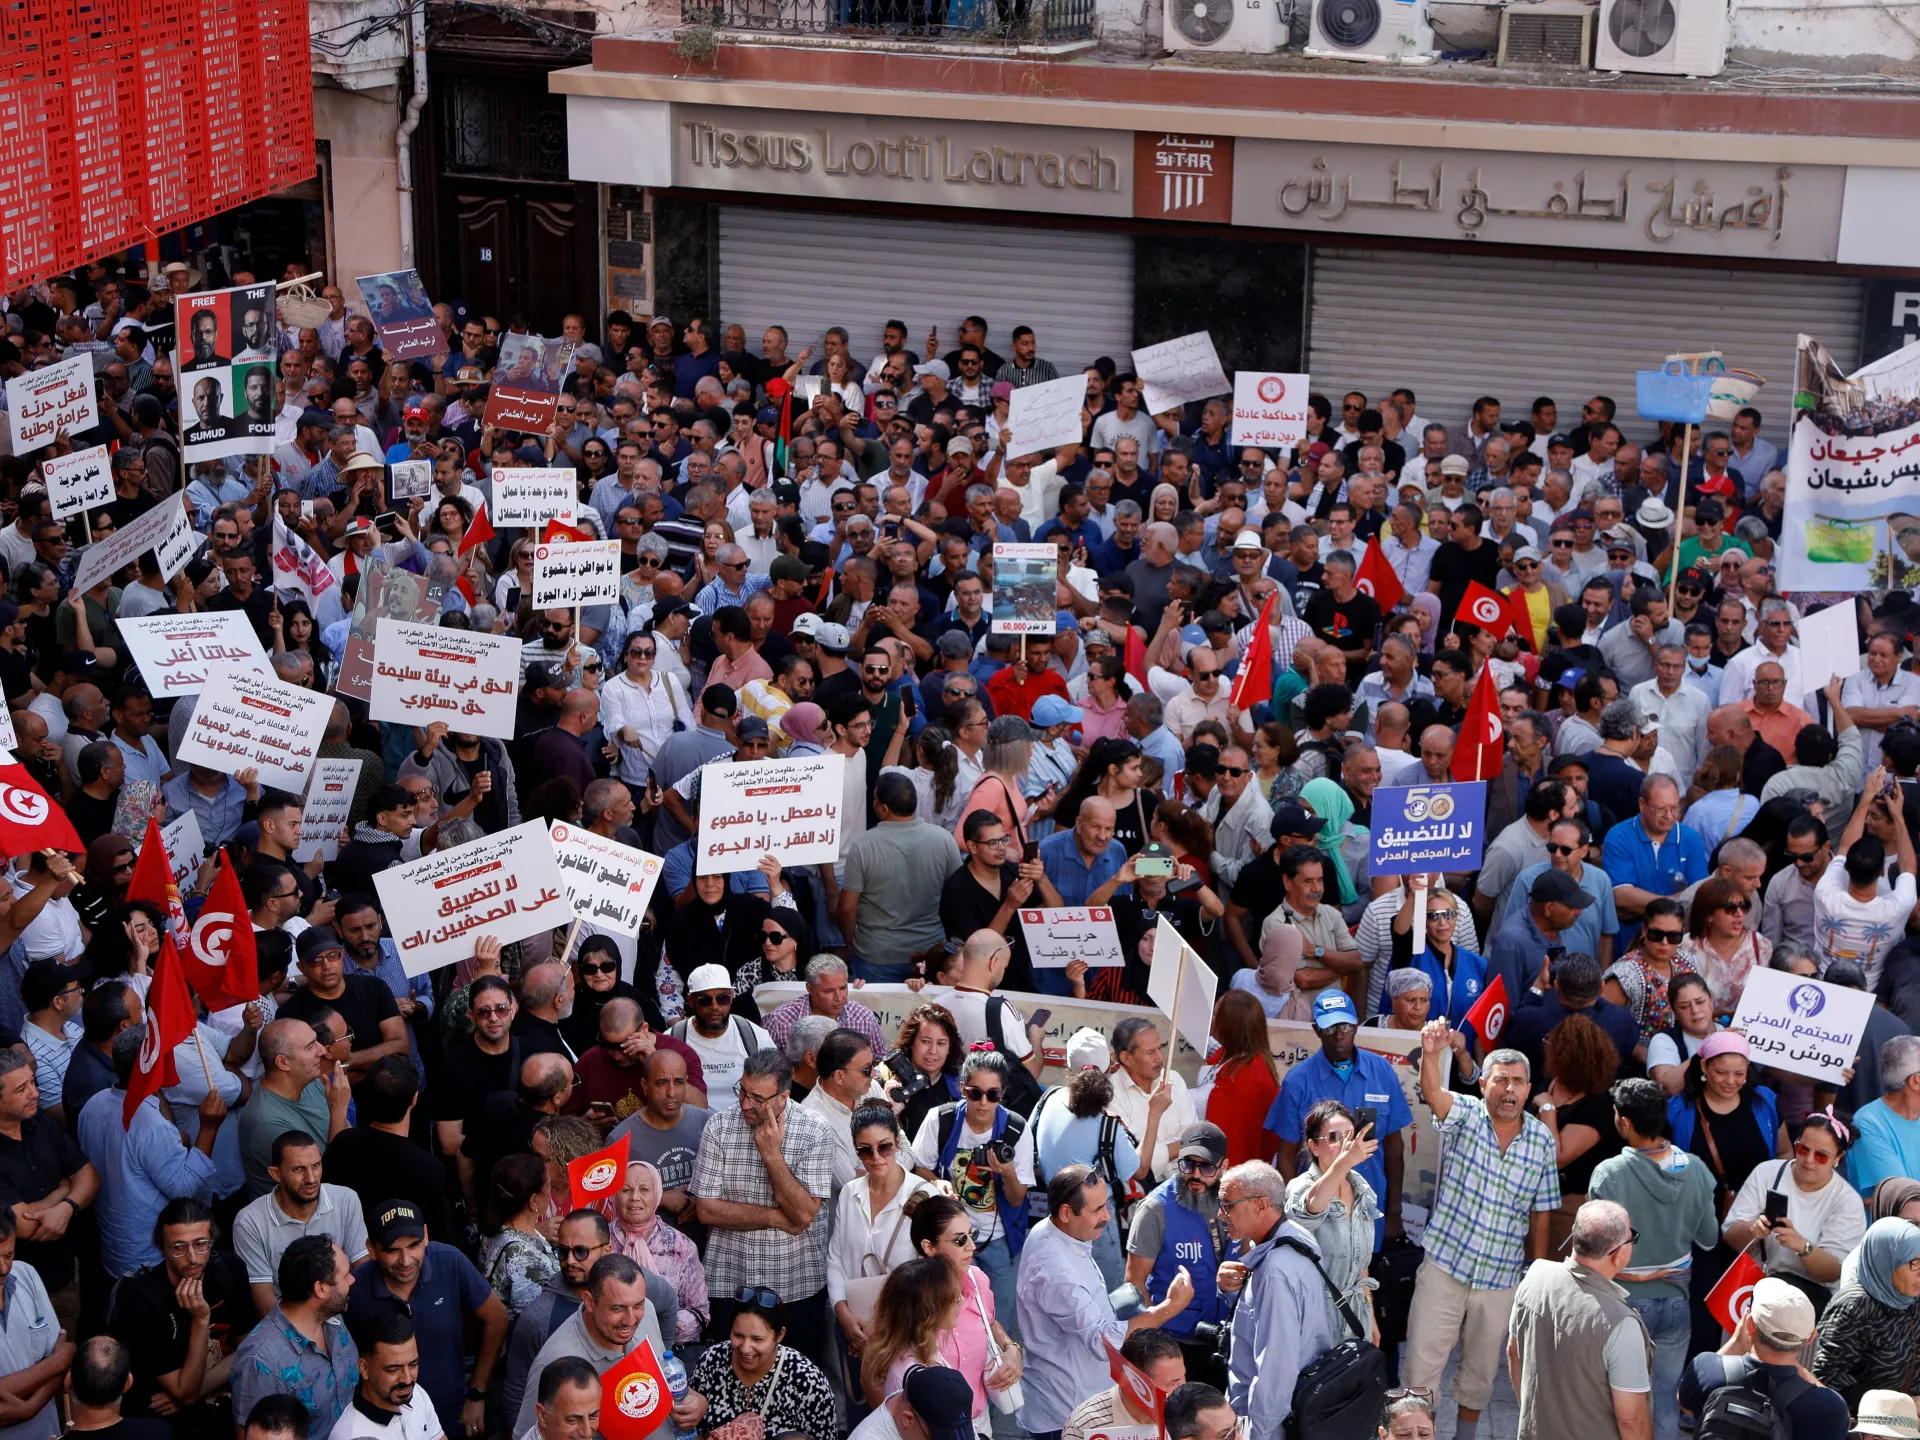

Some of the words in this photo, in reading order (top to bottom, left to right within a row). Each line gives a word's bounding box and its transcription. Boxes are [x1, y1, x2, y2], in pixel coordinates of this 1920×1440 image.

[1247, 0, 1260, 9] LG
[681, 120, 811, 169] Tissus
[816, 127, 930, 180] Lotfi
[938, 135, 1120, 191] Latrach
[1279, 157, 1444, 221] لطرش
[1457, 166, 1632, 240] لطفي
[1645, 166, 1791, 246] أقمشة
[481, 249, 492, 261] 18
[191, 296, 216, 307] FREE
[246, 288, 266, 300] THE
[58, 382, 88, 408] شغل
[57, 405, 90, 427] كرامة
[1236, 408, 1259, 419] عادلة
[1262, 409, 1296, 421] محاكمة
[1299, 412, 1304, 421] لا
[20, 420, 54, 442] وطنية
[190, 427, 226, 442] SUMUD
[1239, 431, 1253, 443] حر
[1255, 430, 1276, 444] دفاع
[1278, 431, 1296, 444] دون
[1810, 439, 1887, 466] جيعان
[59, 474, 81, 488] حرية
[84, 466, 100, 482] شغل
[1807, 468, 1878, 494] شبعان
[85, 484, 109, 501] كرامة
[528, 486, 547, 499] وحدة
[549, 486, 568, 499] وحدة
[56, 494, 83, 511] وطنية
[533, 510, 537, 522] و
[539, 508, 558, 521] القمع
[560, 508, 571, 519] ضد
[542, 562, 568, 578] مقموع
[579, 560, 605, 576] مواطن
[537, 588, 560, 604] الجوع
[563, 587, 576, 601] زاد
[579, 585, 600, 601] الفقر
[603, 584, 617, 598] زاد
[154, 640, 197, 667] أغلى
[198, 644, 252, 662] حياتنا
[377, 661, 422, 681] سليمة
[425, 668, 451, 689] بيئة
[453, 676, 478, 694] في
[481, 678, 513, 695] الحق
[400, 693, 459, 710] دستوري
[461, 699, 485, 716] حق
[196, 714, 231, 733] تهميشا
[253, 717, 265, 726] في
[229, 728, 251, 739] كفى
[290, 745, 312, 758] كفى
[283, 761, 305, 773] كفى
[724, 769, 749, 779] الكرامة
[774, 767, 795, 775] مقاومة
[826, 803, 836, 819] يا
[1403, 787, 1455, 823] 50
[710, 811, 753, 830] مقموع
[757, 810, 767, 825] يا
[781, 806, 822, 823] معطل
[817, 828, 835, 845] زاد
[1377, 822, 1455, 849] للتضييق
[1458, 821, 1473, 839] لا
[498, 834, 523, 847] مقاومة
[708, 837, 750, 857] الجوع
[753, 835, 770, 851] زاد
[783, 831, 815, 849] الفقر
[462, 847, 488, 858] مقاومة
[1375, 850, 1409, 865] المدني
[1410, 847, 1450, 863] المجتمع
[1451, 846, 1472, 859] على
[401, 864, 432, 880] الكرامة
[597, 866, 631, 887] تطبق
[505, 874, 518, 892] لا
[628, 878, 645, 895] لم
[437, 880, 502, 918] لتضييق
[521, 886, 561, 912] على
[573, 894, 593, 915] في
[628, 914, 638, 929] و
[1051, 911, 1086, 924] شغل
[1047, 928, 1098, 943] حرية
[1035, 945, 1077, 960] وطنية
[1078, 945, 1119, 960] كرامة
[1742, 1011, 1791, 1030] المدني
[1791, 1025, 1853, 1046] المجتمع
[1789, 1043, 1845, 1067] موش
[381, 1208, 397, 1225] TOP
[397, 1207, 415, 1220] GUN
[1175, 1237, 1203, 1264] snjt
